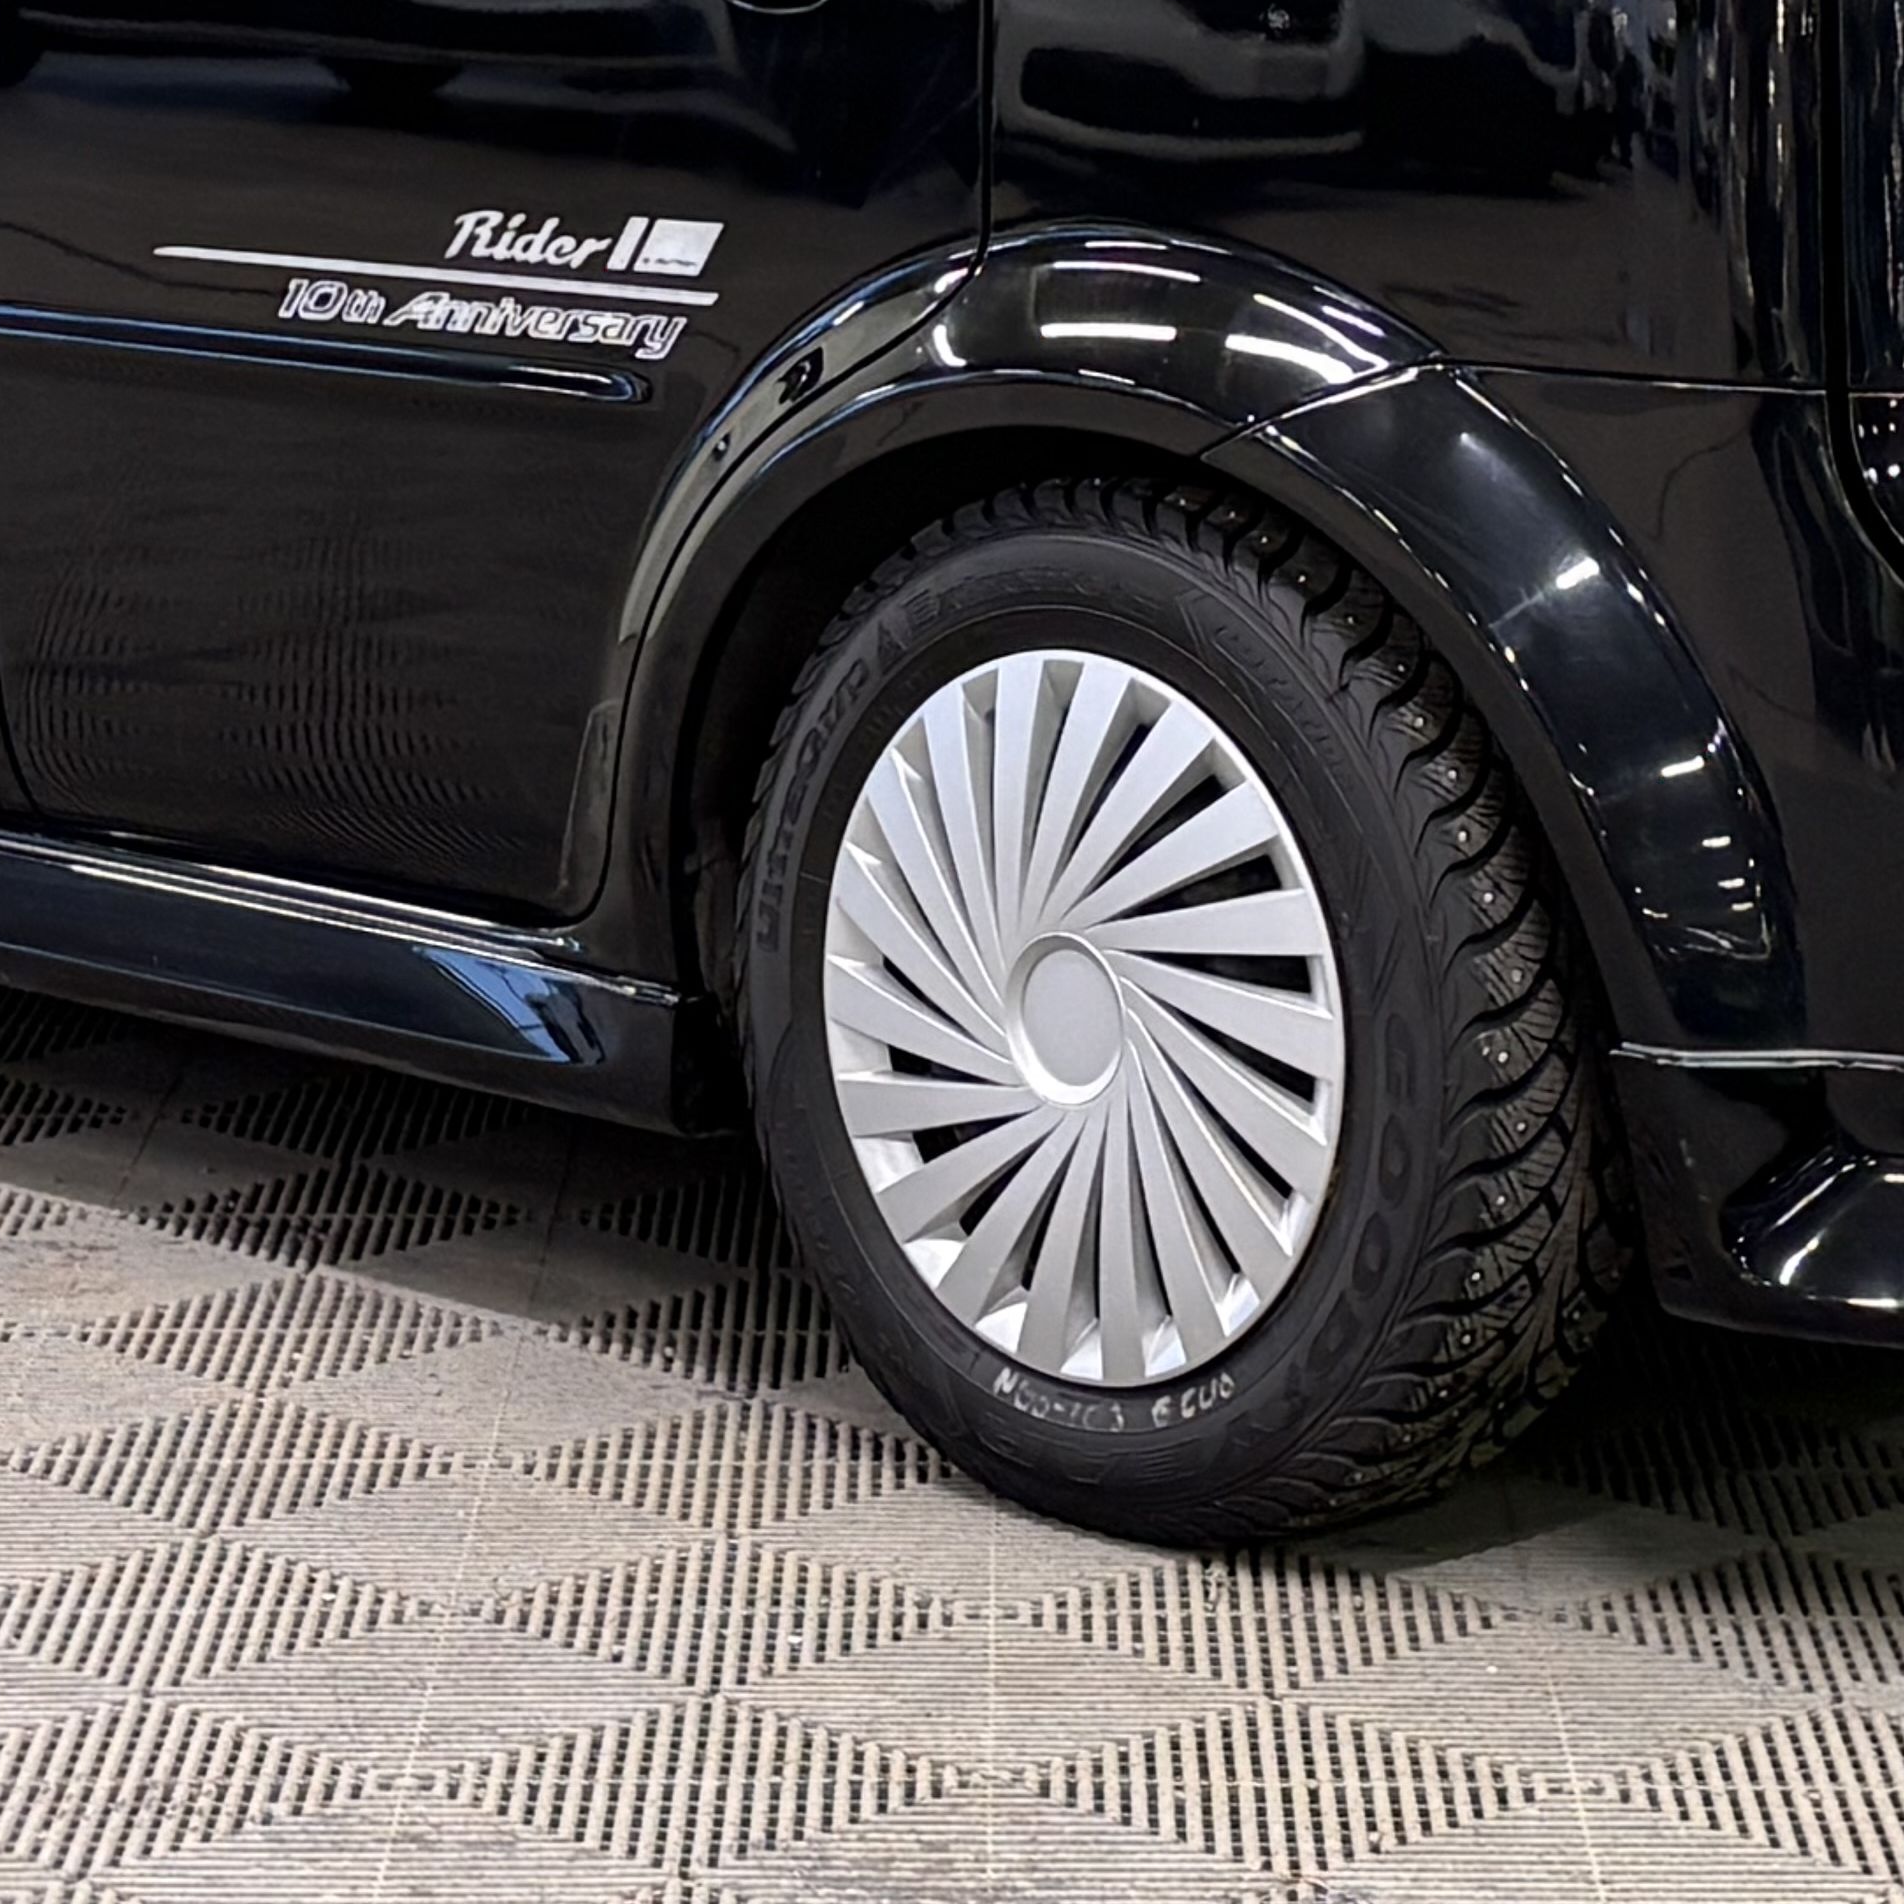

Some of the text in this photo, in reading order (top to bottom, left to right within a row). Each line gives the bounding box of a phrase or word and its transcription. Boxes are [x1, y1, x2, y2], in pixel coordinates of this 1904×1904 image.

[444, 208, 612, 270] Rider
[277, 277, 688, 360] 10th Anniversary
